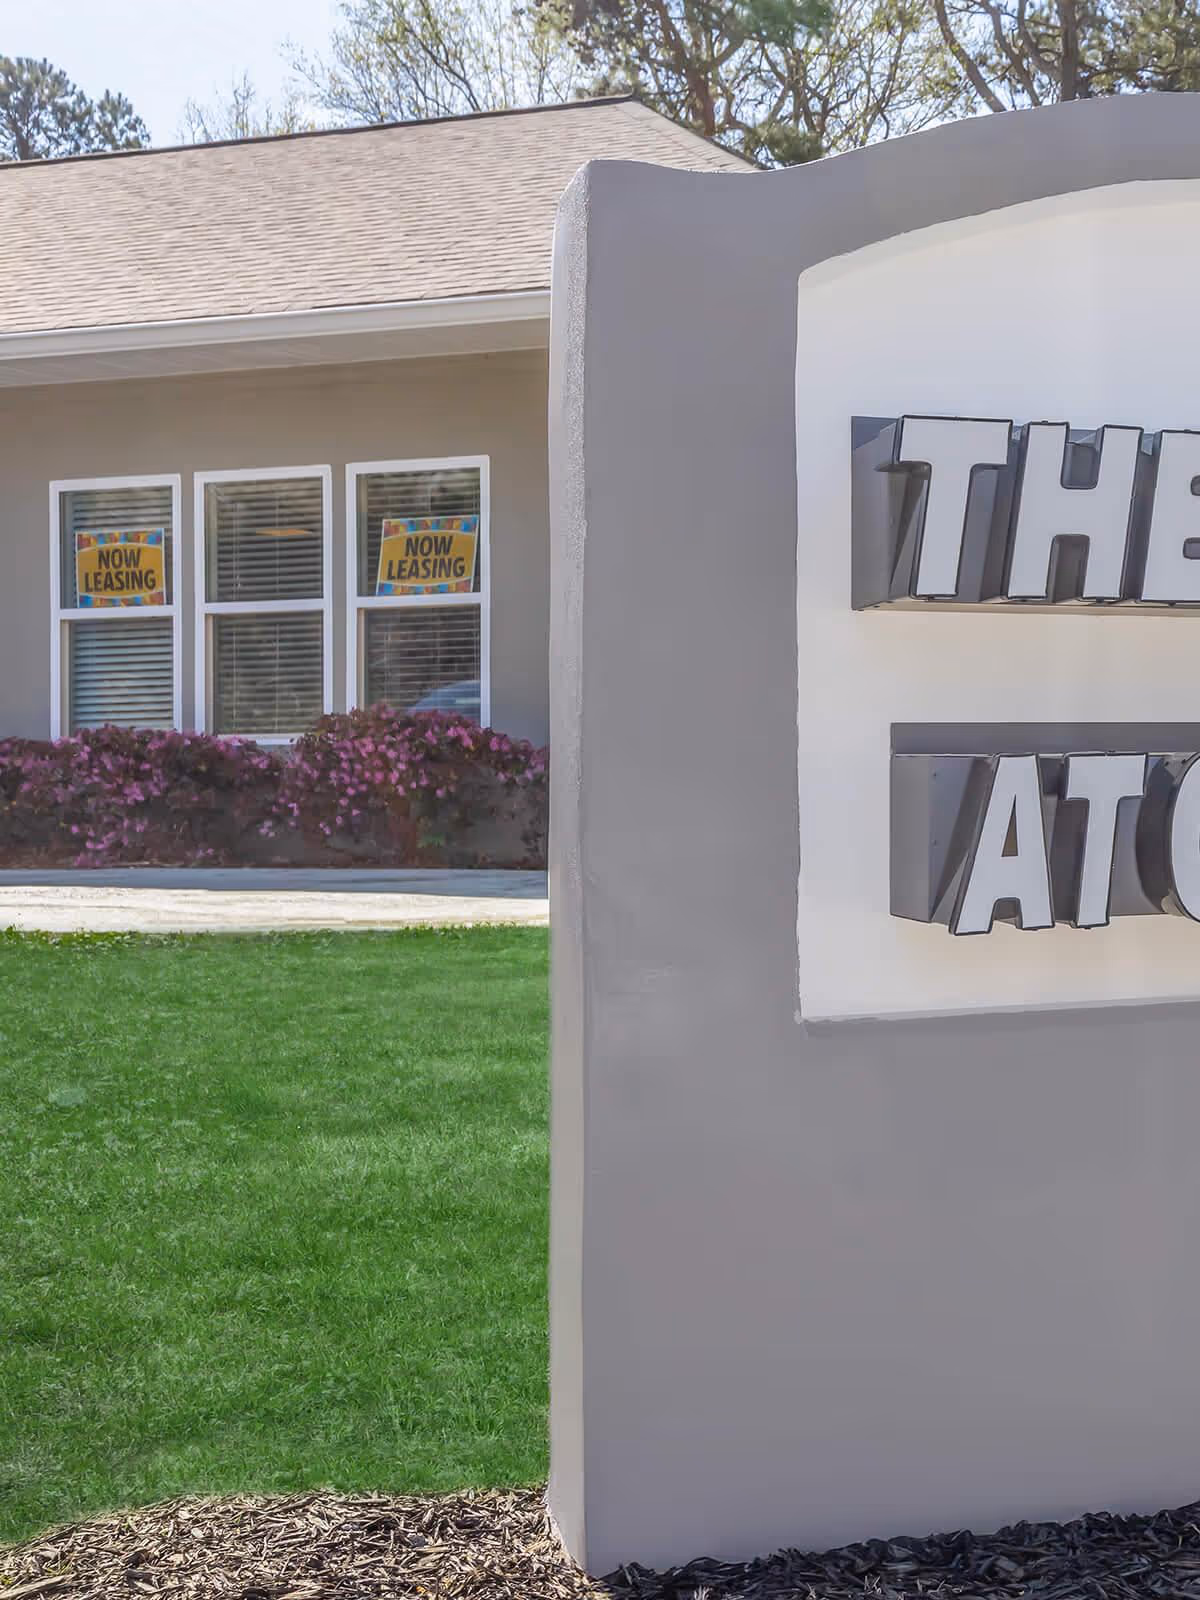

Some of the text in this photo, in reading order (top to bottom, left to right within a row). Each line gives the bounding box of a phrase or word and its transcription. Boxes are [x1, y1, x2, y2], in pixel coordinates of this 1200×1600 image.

[405, 535, 453, 557] NOW
[98, 548, 141, 570] NOW
[387, 557, 465, 580] LEASING
[84, 569, 156, 593] LEASING
[951, 752, 1149, 935] AT
